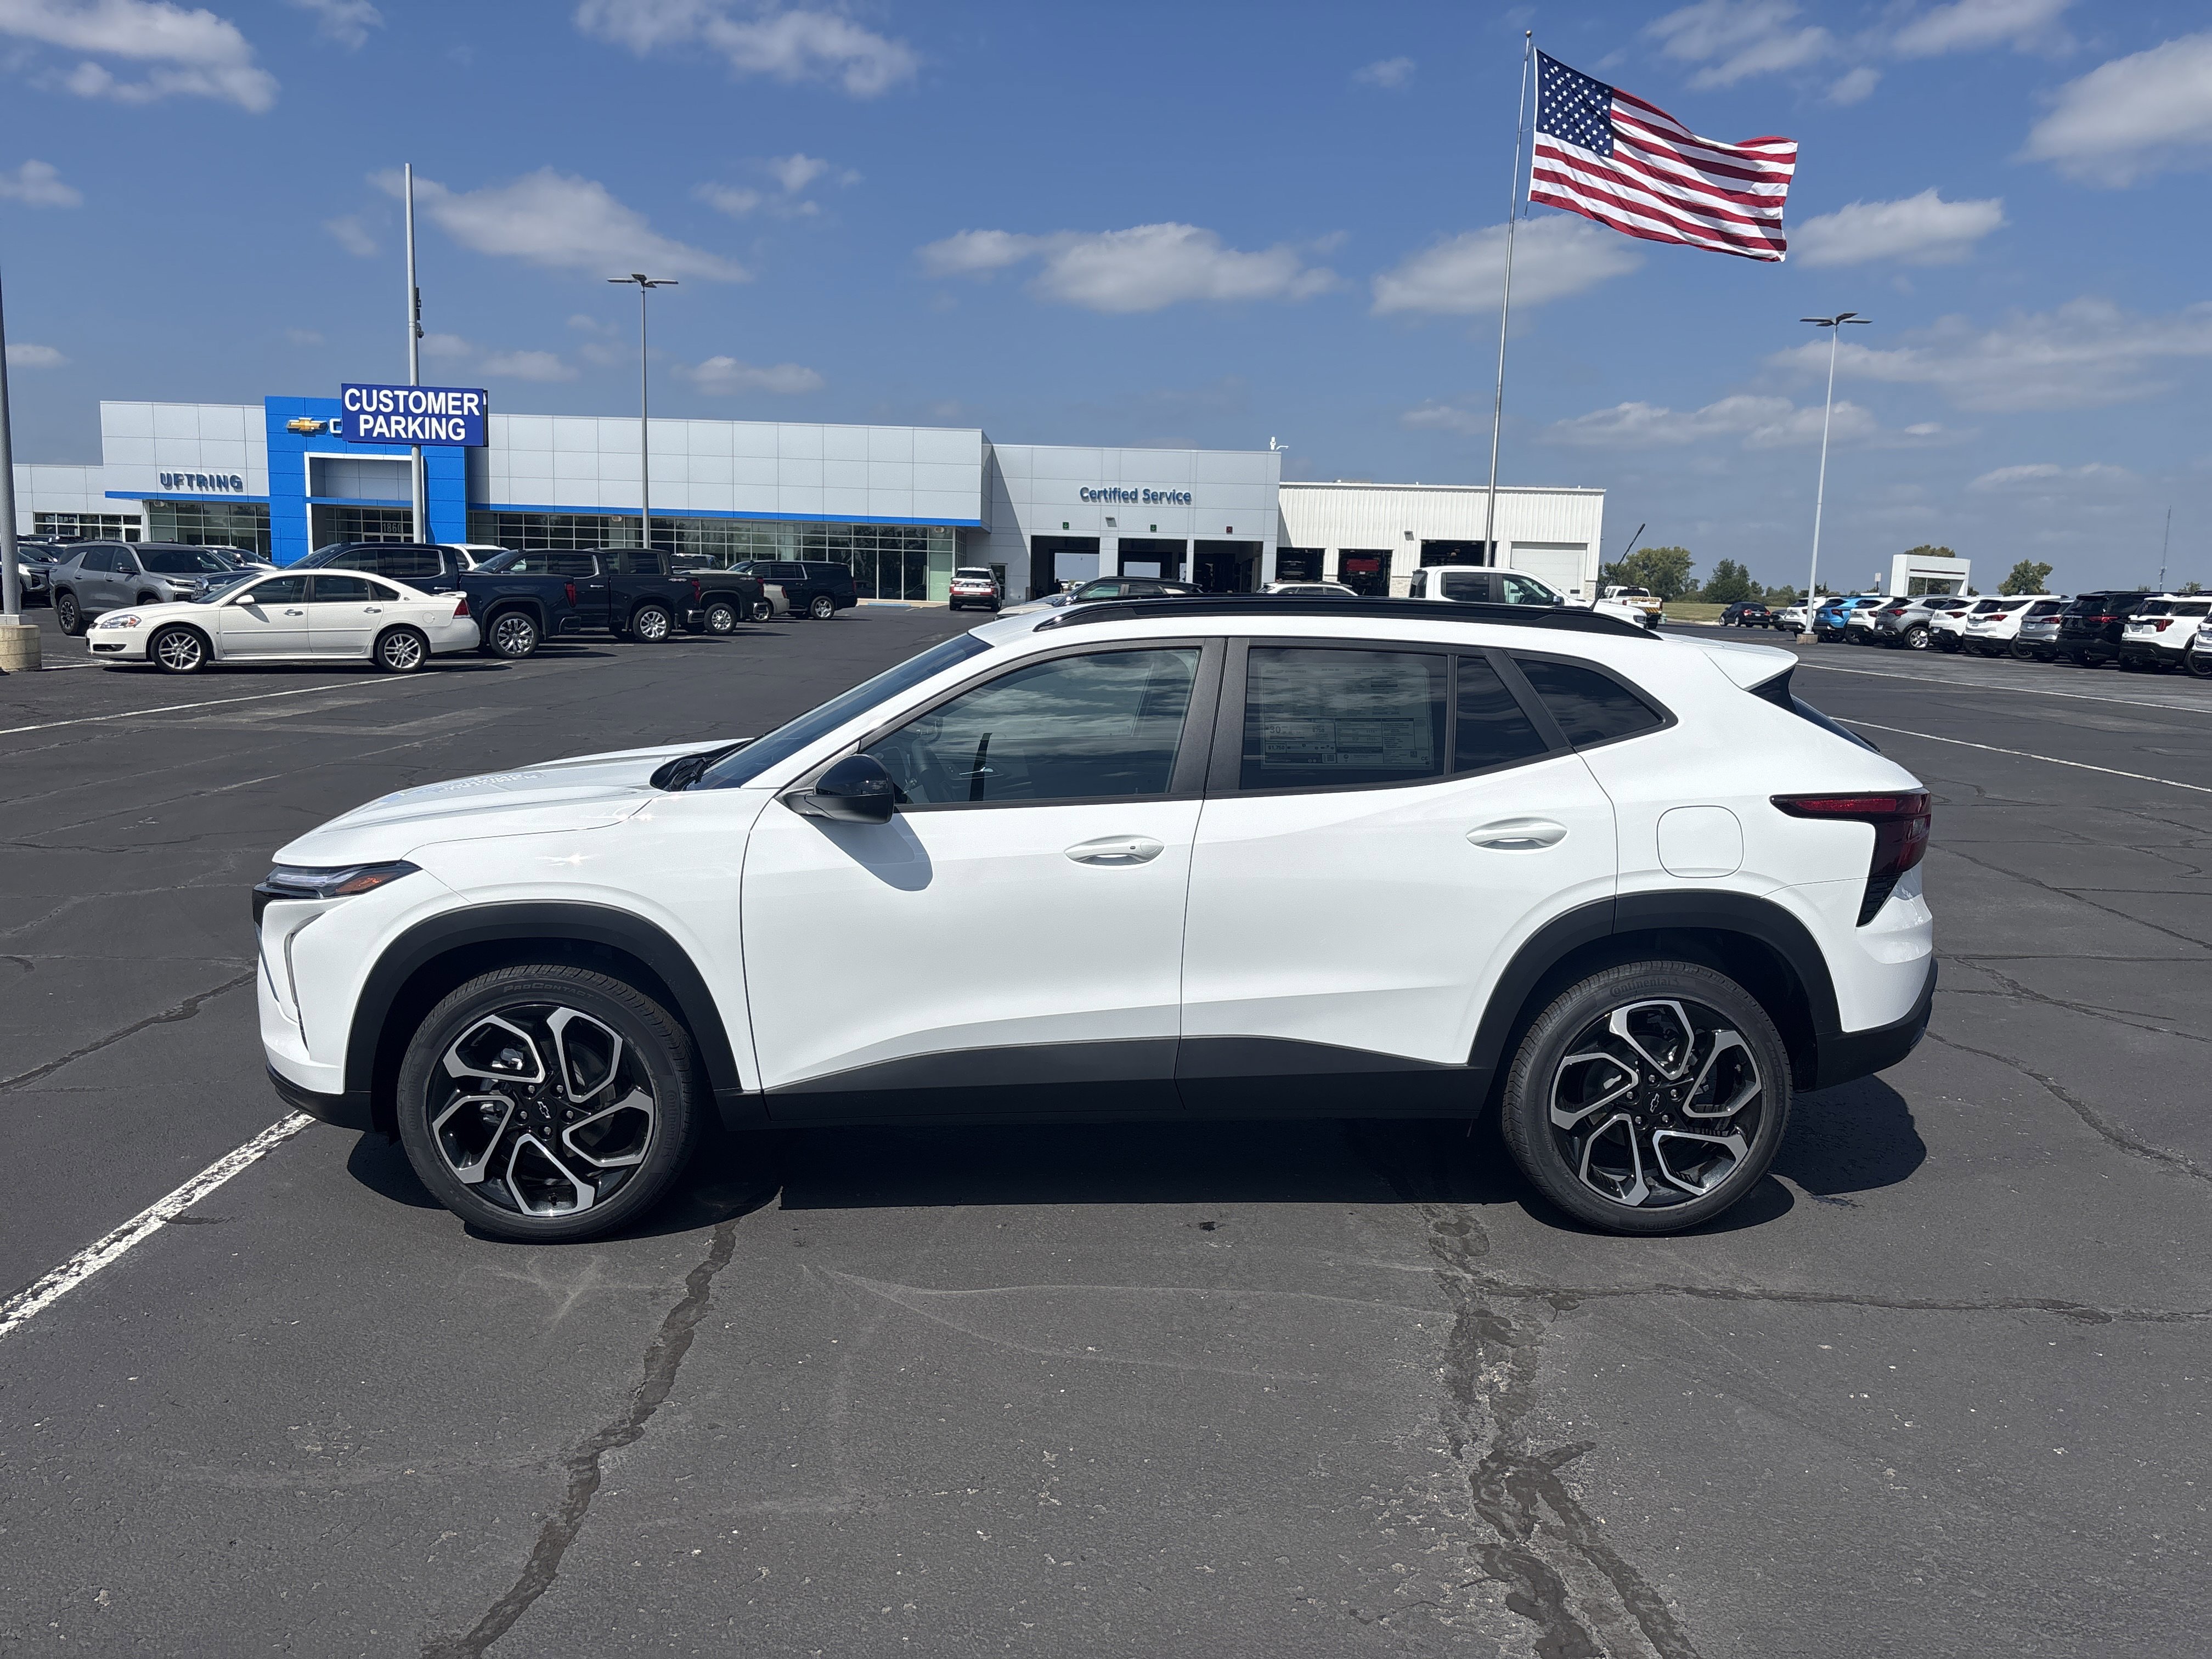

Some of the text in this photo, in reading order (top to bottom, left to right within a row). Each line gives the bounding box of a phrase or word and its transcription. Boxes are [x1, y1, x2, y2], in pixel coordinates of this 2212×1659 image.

[345, 388, 480, 416] CUSTOMER
[359, 415, 465, 441] PARKING
[160, 472, 243, 490] UFTRING
[1080, 487, 1192, 502] Certified Service
[383, 523, 402, 533] 1860
[1610, 977, 1671, 997] Continental
